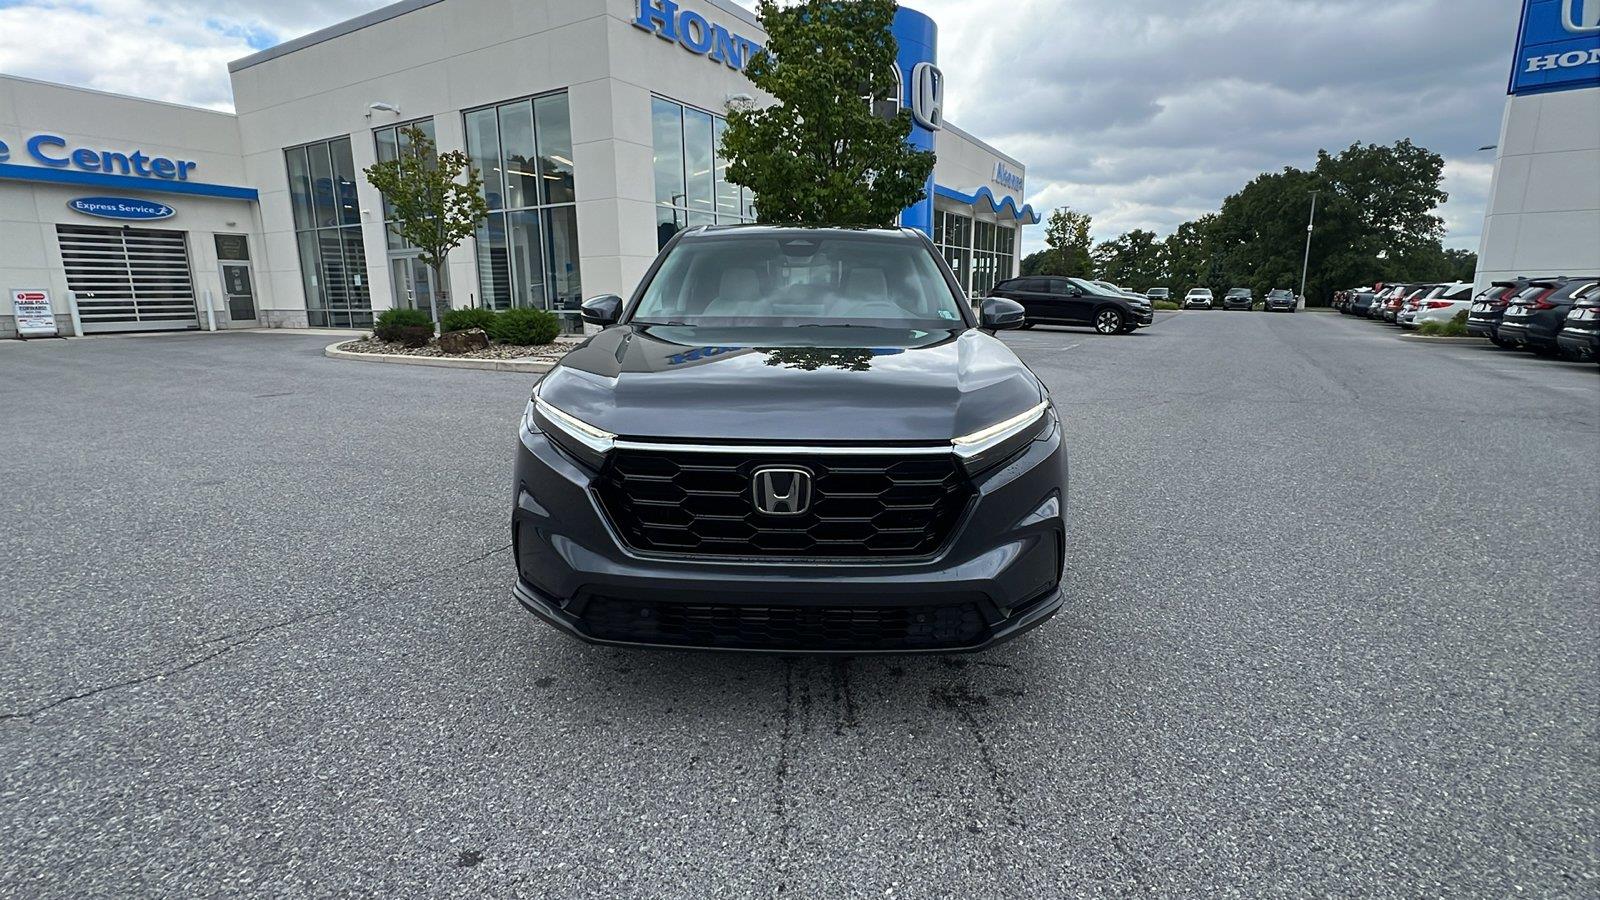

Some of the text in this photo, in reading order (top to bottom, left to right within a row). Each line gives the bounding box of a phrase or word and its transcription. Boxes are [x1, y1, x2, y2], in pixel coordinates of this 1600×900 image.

[27, 134, 196, 180] Center
[76, 201, 155, 214] Express Service
